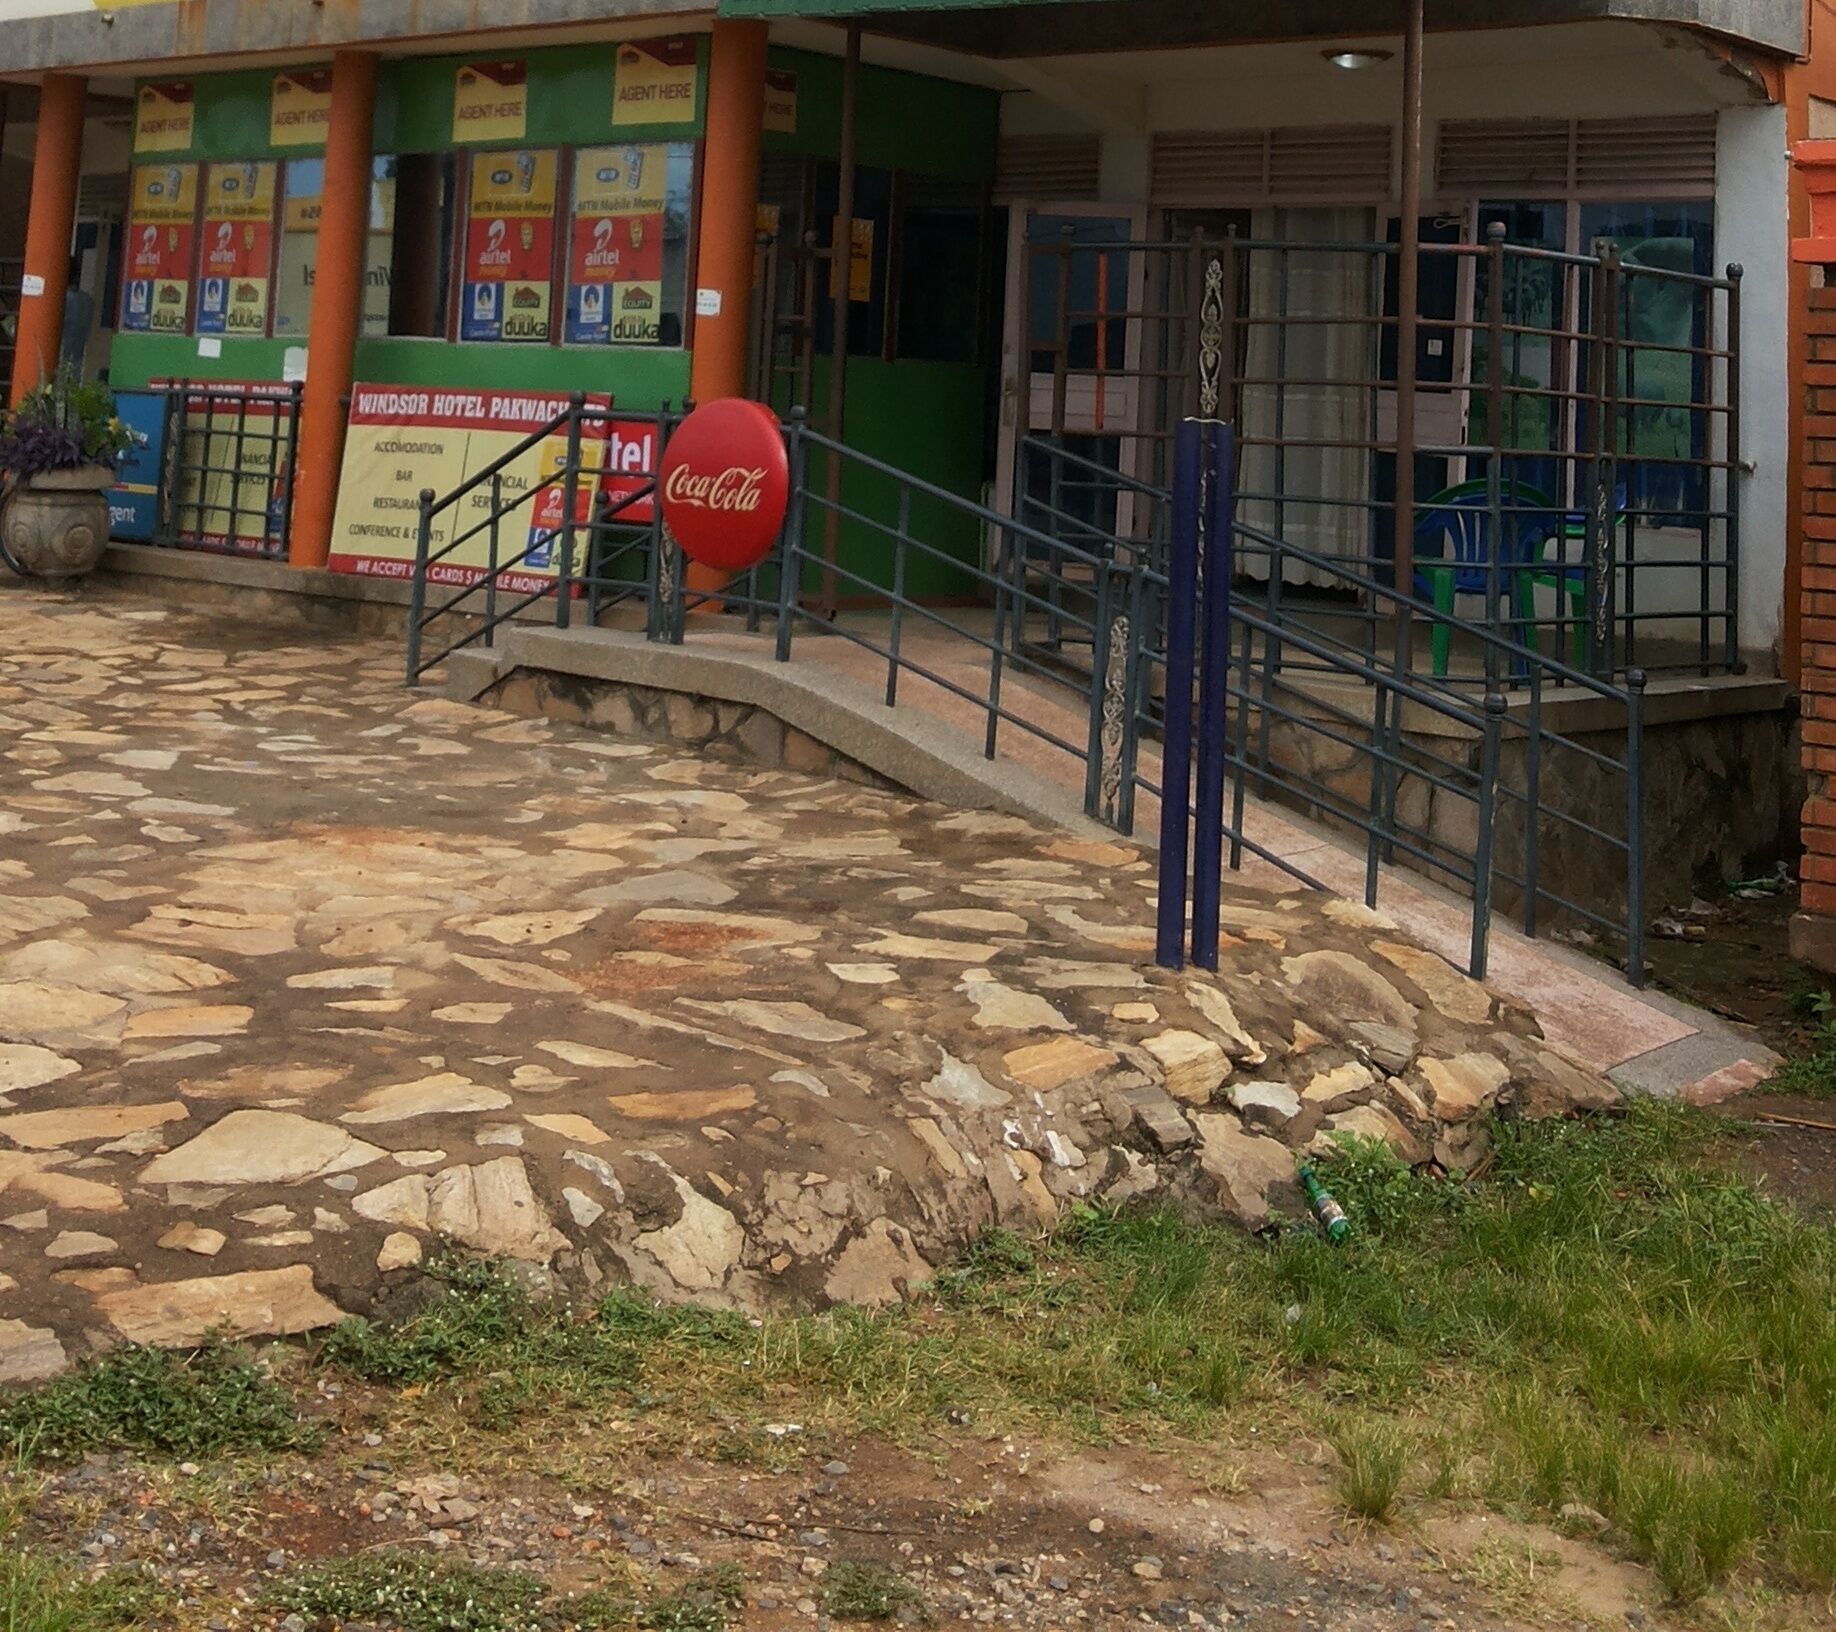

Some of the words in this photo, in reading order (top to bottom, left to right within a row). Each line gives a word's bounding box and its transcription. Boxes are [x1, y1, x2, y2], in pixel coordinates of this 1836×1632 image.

[618, 84, 657, 102] AGENT
[658, 82, 693, 100] HERE
[458, 103, 494, 119] AGENT
[495, 101, 523, 118] HERE
[769, 103, 795, 116] HERE
[600, 199, 631, 210] Mobile
[633, 197, 665, 210] Money
[479, 249, 511, 266] airtel
[584, 249, 620, 267] airtel
[504, 317, 549, 337] duuka
[613, 316, 661, 340] duuka
[358, 393, 429, 415] WINDSOR
[433, 394, 485, 418] HOTEL
[374, 440, 444, 455] ACCOMODATION
[396, 470, 413, 481] BAR
[665, 463, 768, 512] Coca-Cola
[373, 496, 421, 511] RESTAURAN
[349, 523, 401, 539] CONFERENCE
[402, 526, 409, 539] &
[411, 527, 445, 542] ENTS
[356, 559, 370, 573] WE
[371, 560, 408, 577] ACCEPT
[432, 566, 464, 583] CARDS
